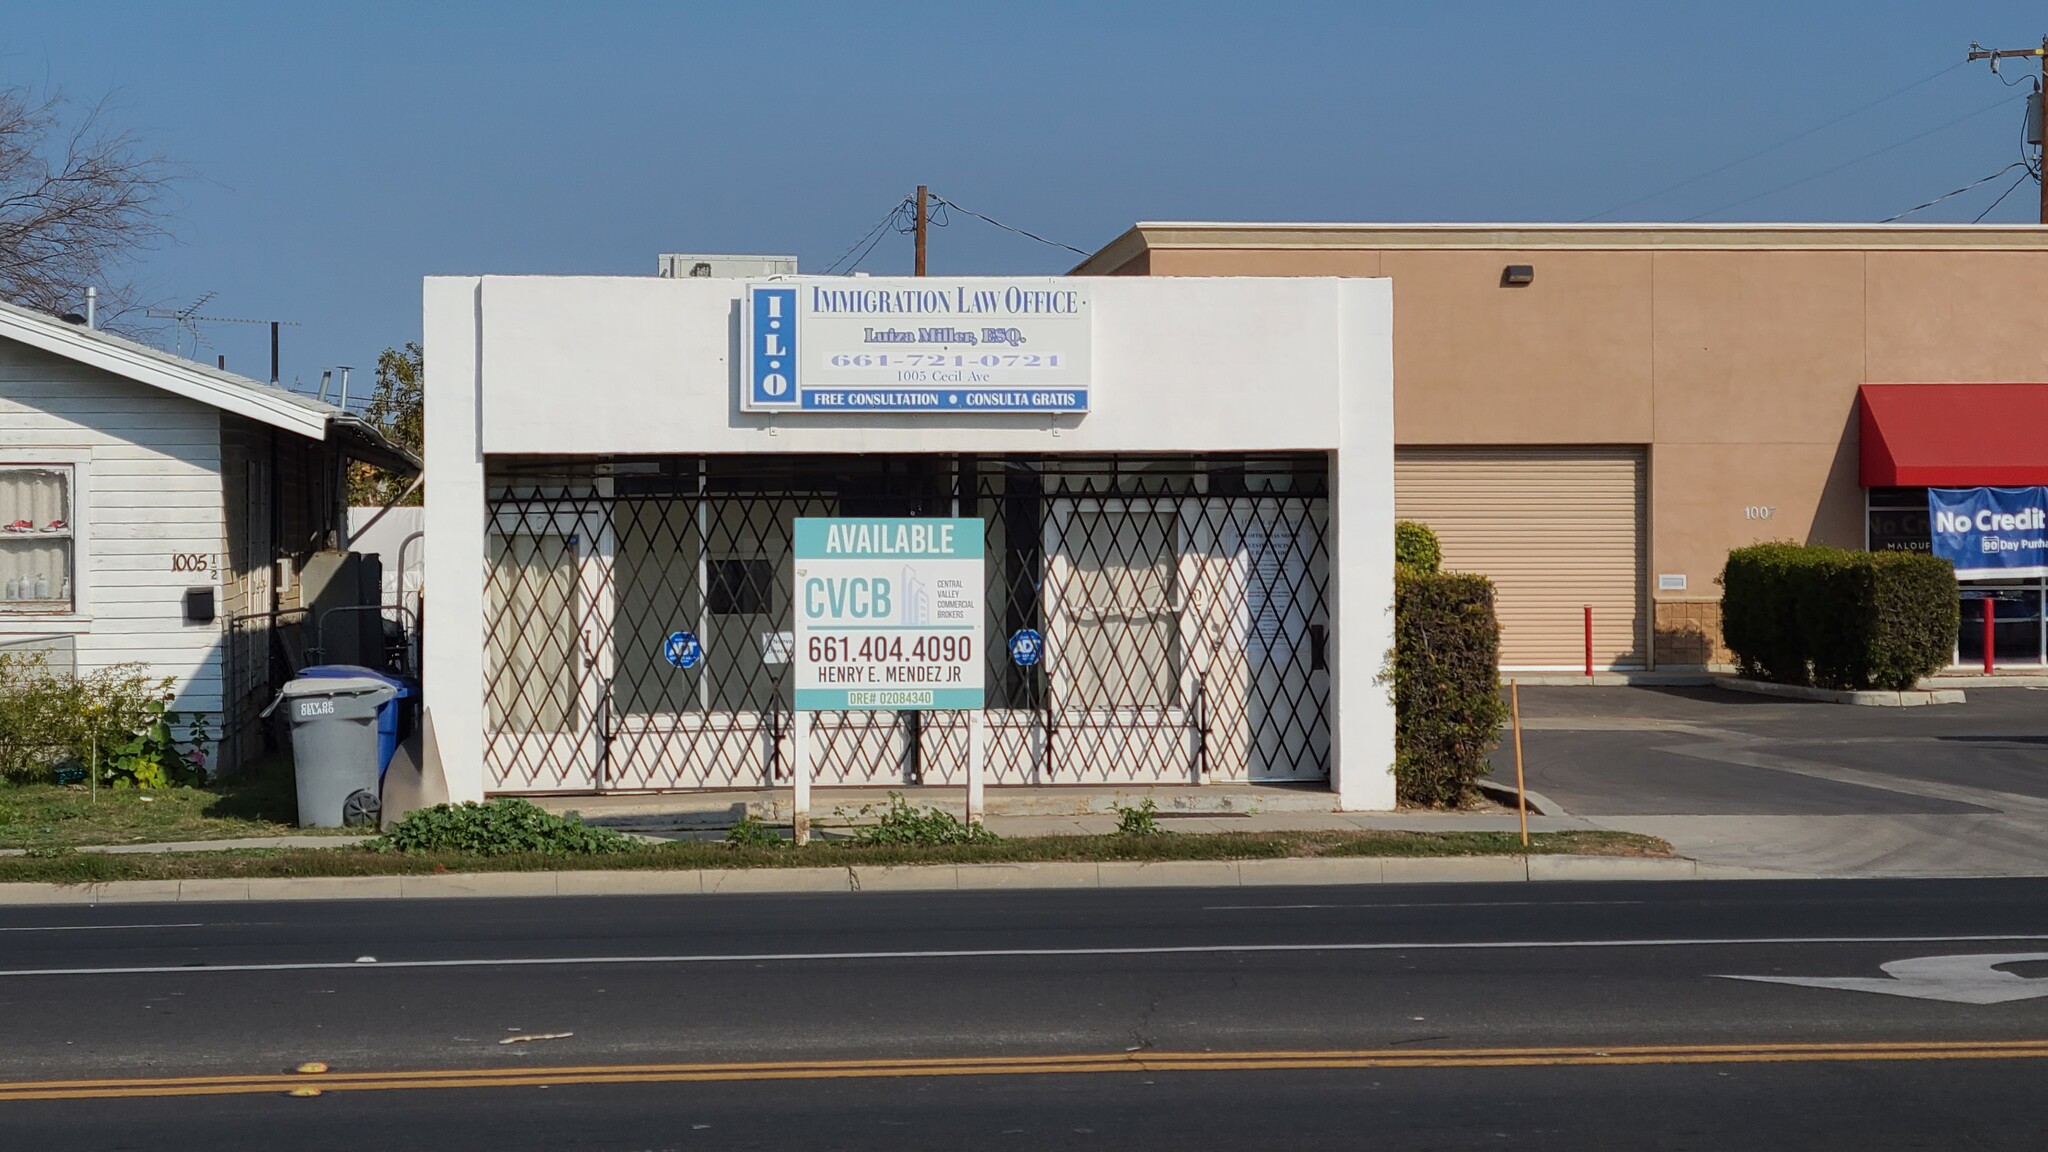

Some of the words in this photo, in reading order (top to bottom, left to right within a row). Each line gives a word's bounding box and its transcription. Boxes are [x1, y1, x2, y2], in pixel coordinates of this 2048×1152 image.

[812, 285, 951, 314] IMMIGRATION
[957, 286, 1000, 313] LAW
[1004, 285, 1078, 314] OFFICE
[864, 328, 916, 344] Luiza
[918, 327, 978, 346] Miller,
[981, 328, 1027, 346] ESQ.
[831, 354, 1059, 368] 661-721-0721
[897, 370, 927, 382] 1005
[932, 369, 963, 382] Cecil
[967, 370, 990, 382] Ave
[813, 393, 846, 406] FREE
[848, 393, 939, 406] CONSULTATION
[966, 394, 1030, 406] CONSULTA
[1032, 394, 1076, 406] GRATIS
[1936, 511, 1972, 533] No
[1975, 508, 2046, 532] Credit
[826, 524, 954, 553] AVAILABLE
[1983, 540, 1998, 551] 90
[2000, 540, 2019, 552] Day
[171, 553, 208, 572] 1005
[937, 580, 964, 588] CENTRAL
[805, 577, 892, 619] CVCB
[937, 590, 960, 598] VALLEY
[937, 600, 975, 609] COMMERCIAL
[937, 611, 964, 619] BROKERS
[808, 636, 972, 662] 661.404.4090
[1013, 639, 1041, 654] ADT
[818, 666, 864, 682] HENRY
[868, 666, 880, 682] E.
[886, 666, 942, 682] MENDEZ
[946, 666, 961, 682] JR
[850, 692, 876, 704] DRE#
[880, 691, 931, 705] 02084340
[301, 702, 320, 710] CITY
[321, 701, 334, 709] OF
[301, 707, 334, 716] DELANO
